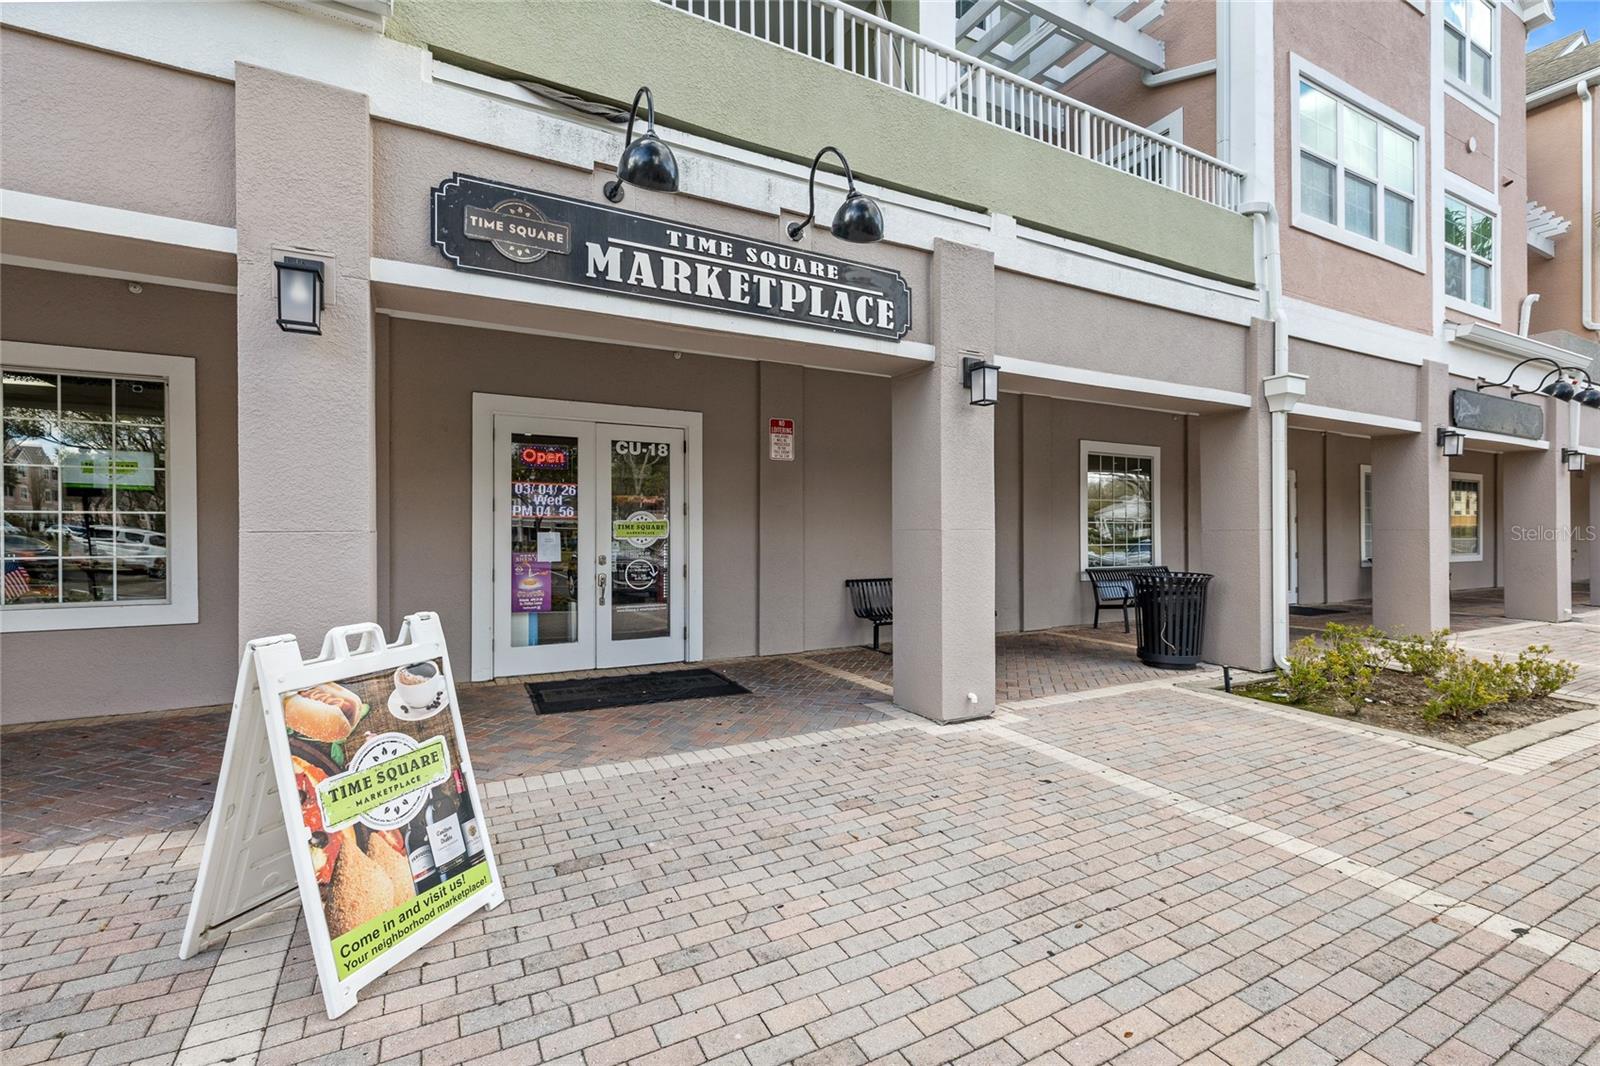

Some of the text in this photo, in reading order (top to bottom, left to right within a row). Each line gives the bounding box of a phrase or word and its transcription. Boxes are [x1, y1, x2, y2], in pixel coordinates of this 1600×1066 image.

[470, 215, 564, 244] TIME SQUARE
[666, 229, 839, 280] TIME SQUARE
[586, 242, 894, 330] MARKETPLACE
[522, 448, 565, 465] Open
[615, 441, 669, 457] CU-18
[533, 494, 563, 506] Wed
[561, 484, 577, 496] 26
[512, 505, 533, 517] PM
[328, 751, 440, 803] TIME SQUARE
[355, 775, 421, 807] MARKETPLACE
[340, 874, 466, 959] Come in and visit us!
[343, 876, 488, 972] Your neighborhood marketplace!
